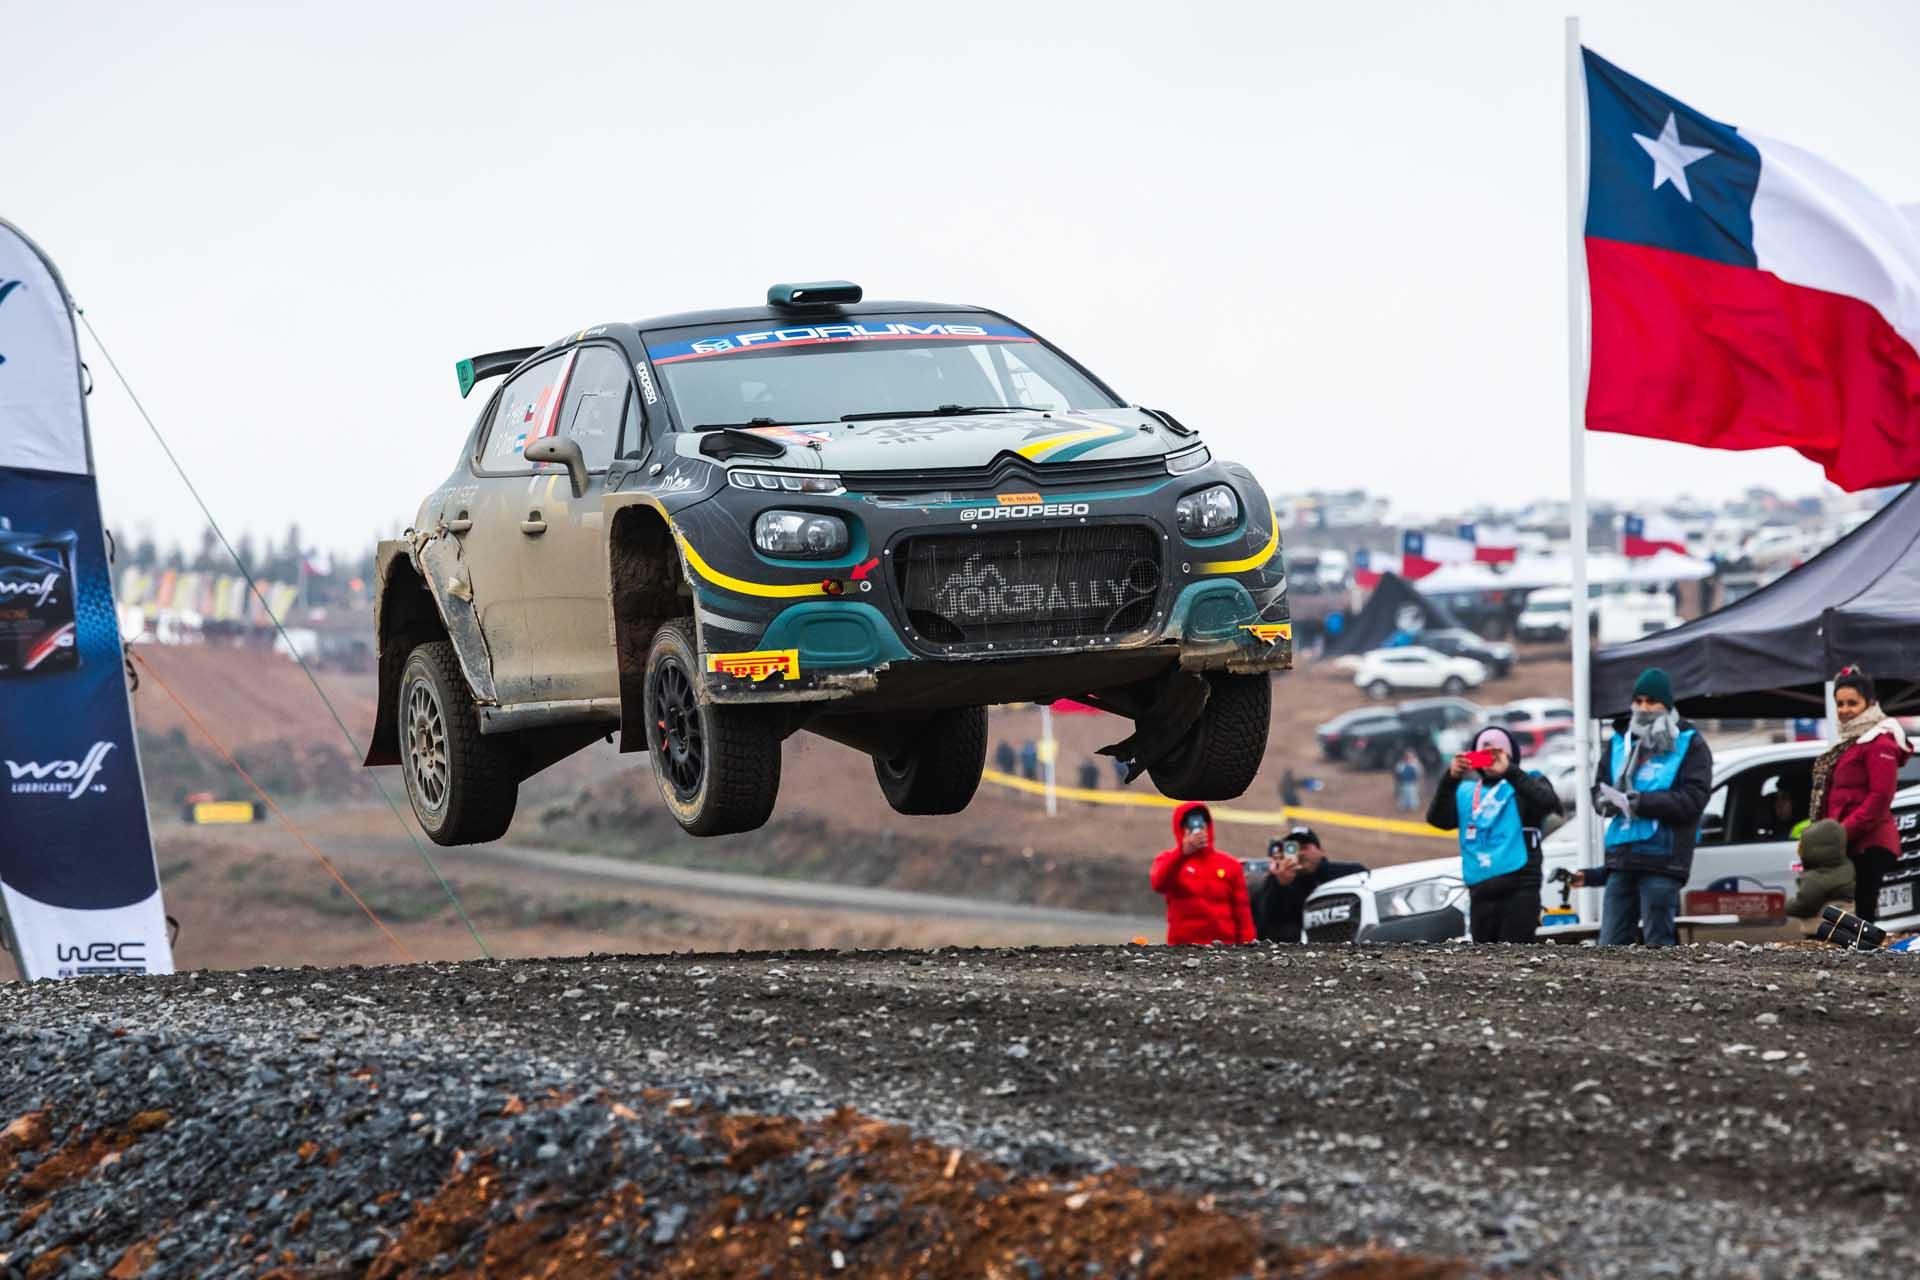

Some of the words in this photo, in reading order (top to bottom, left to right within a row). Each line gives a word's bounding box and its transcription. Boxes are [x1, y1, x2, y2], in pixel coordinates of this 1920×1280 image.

[736, 323, 987, 346] FORUM8
[960, 503, 1089, 521] @DROPE50
[57, 943, 146, 962] WRC
